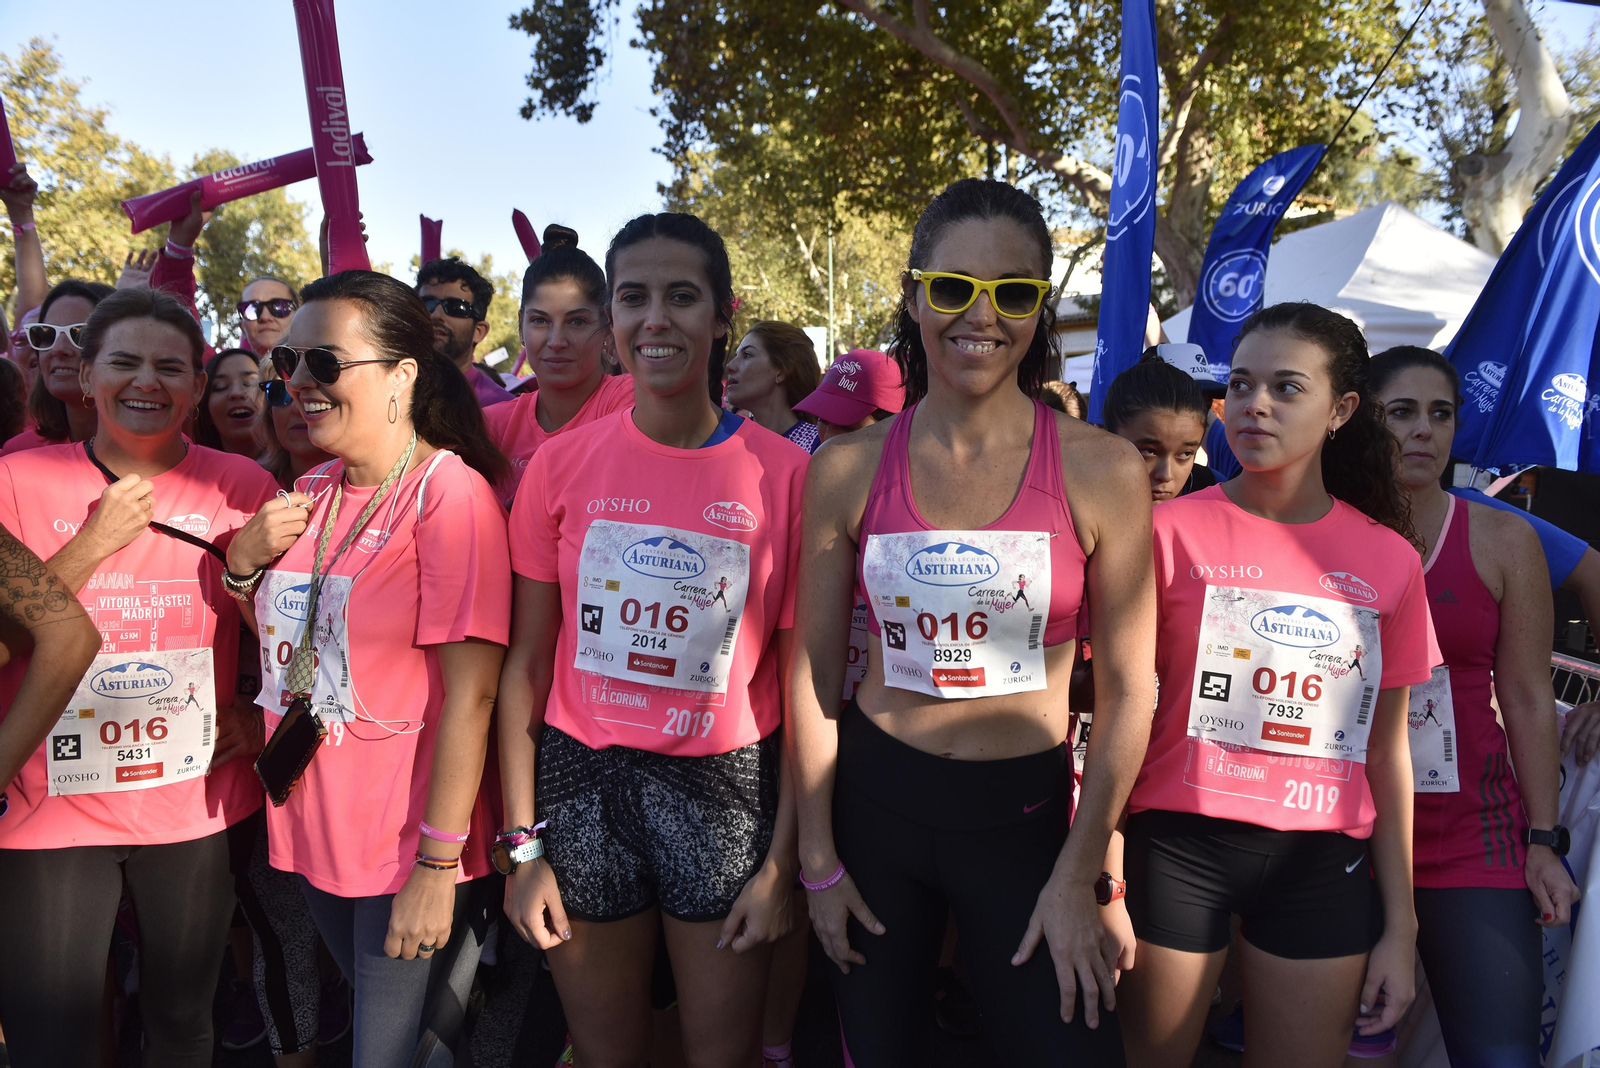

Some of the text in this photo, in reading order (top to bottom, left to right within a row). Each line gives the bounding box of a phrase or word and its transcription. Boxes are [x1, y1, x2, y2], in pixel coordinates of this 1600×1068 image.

[315, 86, 352, 167] Ladival
[1465, 371, 1499, 398] Carrera
[586, 497, 651, 514] OYSHO
[707, 508, 754, 529] ASTURIANA
[627, 549, 699, 573] ASTURIANA
[912, 559, 993, 576] ASTURIANA
[1190, 564, 1263, 579] OYSHO
[673, 581, 707, 595] Carrera
[968, 586, 1005, 598] Carrera
[1325, 577, 1374, 600] ASTURIANA
[100, 597, 141, 608] VITORIA
[151, 595, 192, 607] GASTEIZ
[690, 593, 717, 611] Mujer
[976, 598, 984, 606] de
[989, 597, 1017, 614] Mujer
[122, 607, 165, 620] MADRID
[619, 598, 690, 633] 016
[916, 612, 989, 642] 016
[1257, 615, 1334, 642] ASTURIANA
[128, 632, 139, 640] KM
[631, 633, 668, 651] 2014
[933, 648, 972, 663] 8929
[1309, 649, 1342, 664] Carrera
[640, 660, 669, 671] Santander
[892, 663, 923, 679] OYSHO
[1314, 661, 1322, 669] de
[1325, 663, 1351, 680] Mujer
[96, 676, 168, 692] ASTURIANA
[947, 674, 979, 682] Santander
[1002, 675, 1032, 685] ZURICH
[1252, 667, 1323, 702] 016
[147, 695, 179, 706] Carrera
[609, 691, 648, 709] CORUÑA
[320, 707, 343, 715] ZURICH
[1268, 702, 1304, 720] 7932
[99, 716, 169, 745] 016
[662, 707, 715, 738] 2019
[1199, 714, 1244, 731] OYSHO
[1276, 729, 1306, 739] Santander
[117, 747, 151, 761] 5431
[1324, 742, 1354, 753] ZURICH
[57, 772, 100, 784] OYSHO
[129, 767, 158, 777] Santander
[176, 764, 201, 775] ZURICH
[1226, 763, 1266, 780] CORUÑA
[1283, 779, 1341, 814] 2019
